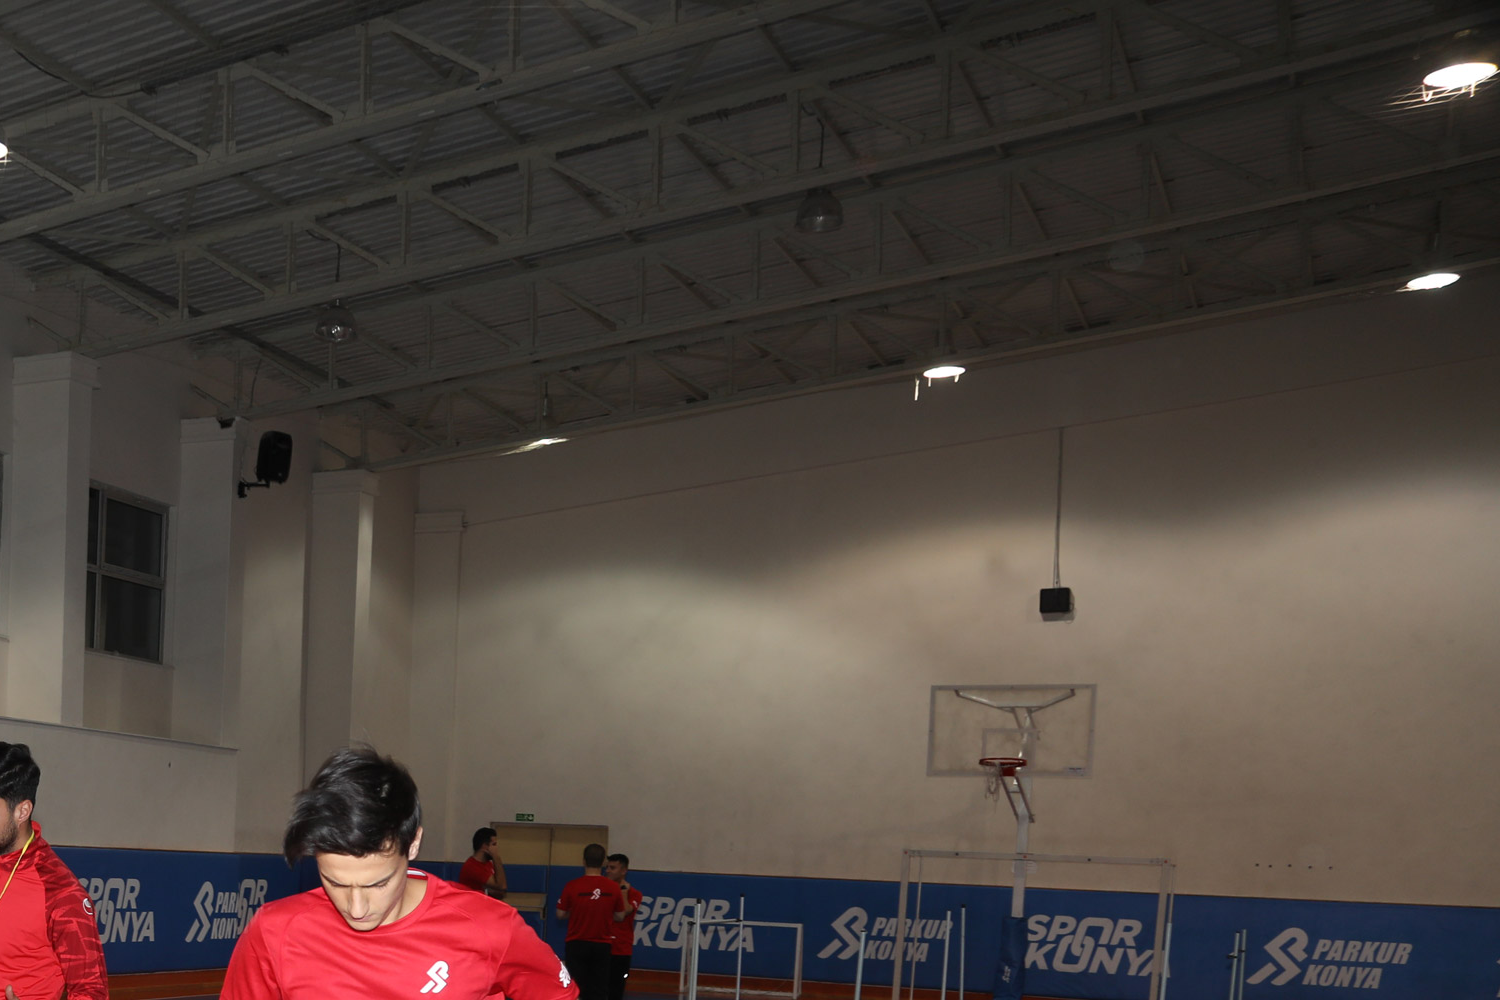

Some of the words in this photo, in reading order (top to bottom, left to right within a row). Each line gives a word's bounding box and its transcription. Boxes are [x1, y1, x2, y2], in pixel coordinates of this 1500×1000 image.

[79, 878, 140, 924] POR
[94, 901, 155, 944] ONYA
[211, 918, 239, 939] KONY
[1027, 914, 1143, 957] SPOR
[1312, 938, 1413, 965] PARKUR
[1302, 964, 1383, 989] KONYA
